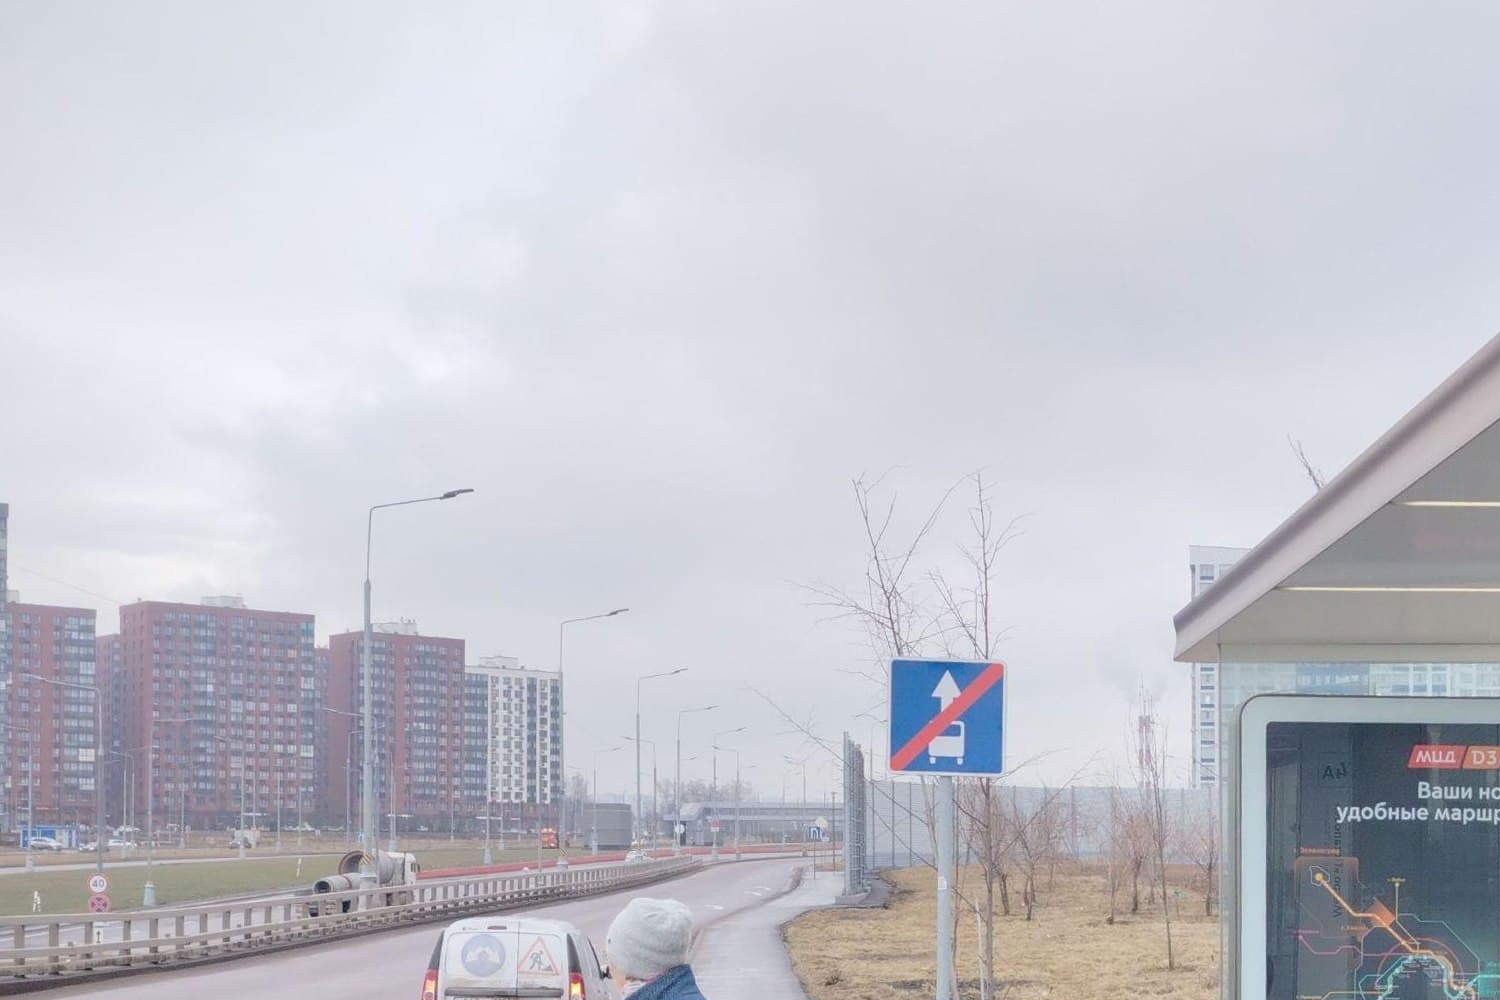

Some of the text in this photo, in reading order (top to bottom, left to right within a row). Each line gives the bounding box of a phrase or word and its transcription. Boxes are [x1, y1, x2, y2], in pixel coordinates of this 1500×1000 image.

[1416, 750, 1456, 764] МЦД
[1472, 750, 1497, 765] D3
[1418, 781, 1472, 800] Ваши
[1337, 802, 1429, 823] удобные
[92, 879, 105, 888] 40
